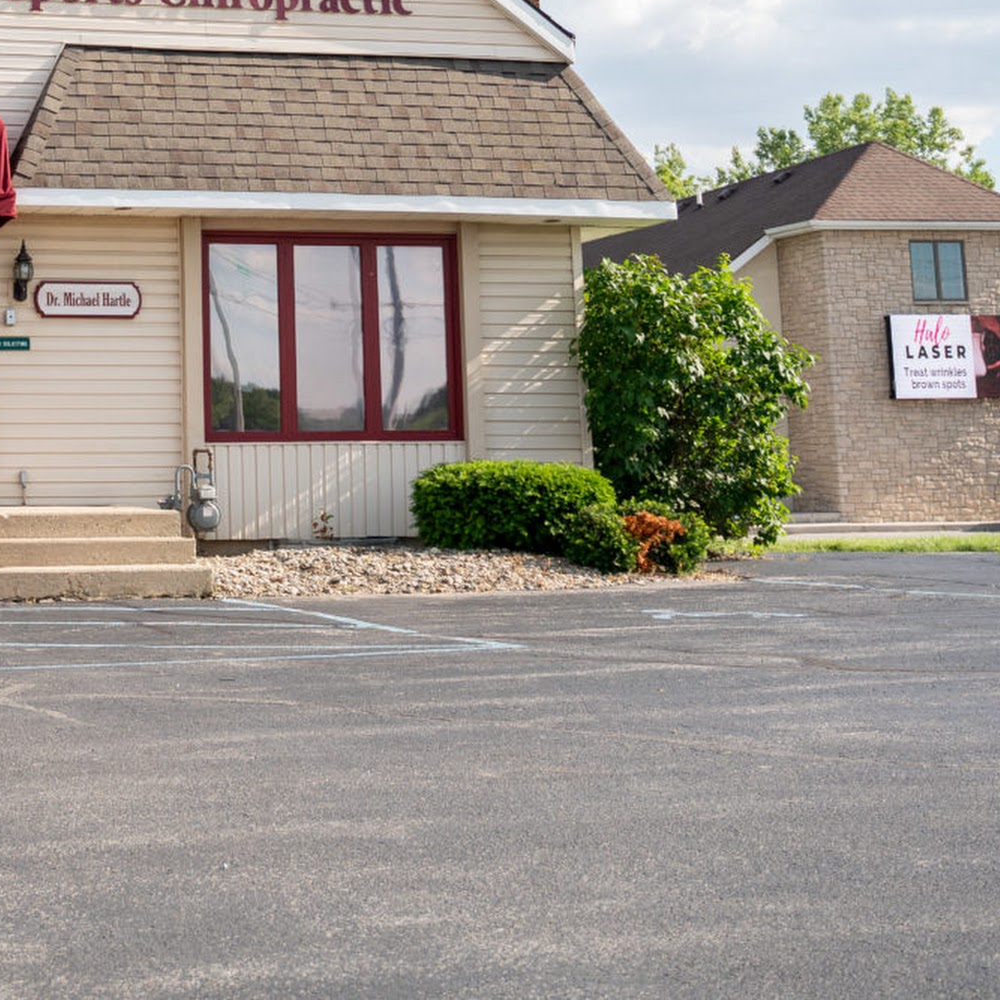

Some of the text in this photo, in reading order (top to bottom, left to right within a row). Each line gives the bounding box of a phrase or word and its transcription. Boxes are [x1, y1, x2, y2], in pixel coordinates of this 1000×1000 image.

[46, 292, 131, 307] Dr. Michael Hartle
[906, 345, 966, 359] LASER
[904, 367, 967, 377] Treat wrinkles
[912, 380, 966, 391] brown spots
